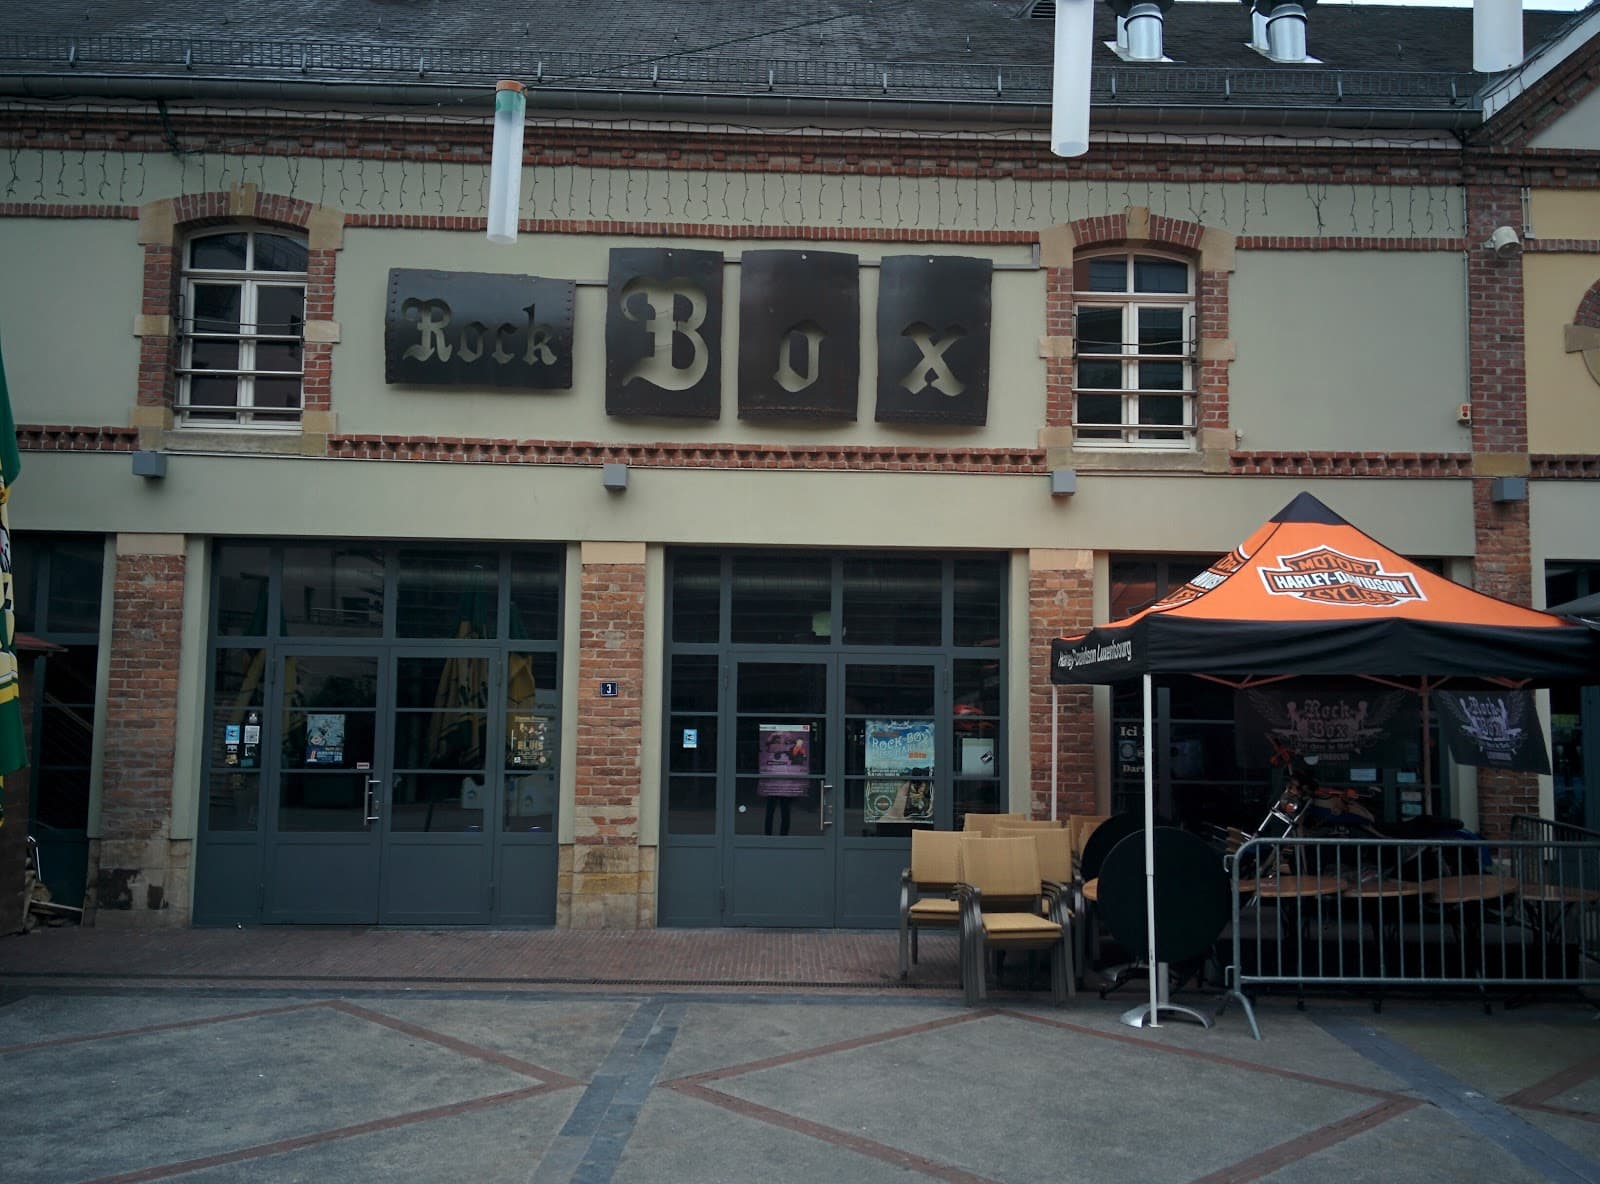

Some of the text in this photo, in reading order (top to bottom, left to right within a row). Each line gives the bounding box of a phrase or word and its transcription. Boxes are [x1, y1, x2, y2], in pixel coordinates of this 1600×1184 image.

[401, 275, 967, 397] Rock Box
[1300, 554, 1367, 574] MOTOR
[1273, 571, 1409, 594] HARLEY-DAVIDSON
[1313, 586, 1390, 602] CYCLES
[606, 683, 612, 694] 3
[1304, 699, 1352, 719] Rock
[1120, 726, 1138, 737] Ici
[1311, 719, 1346, 738] Box
